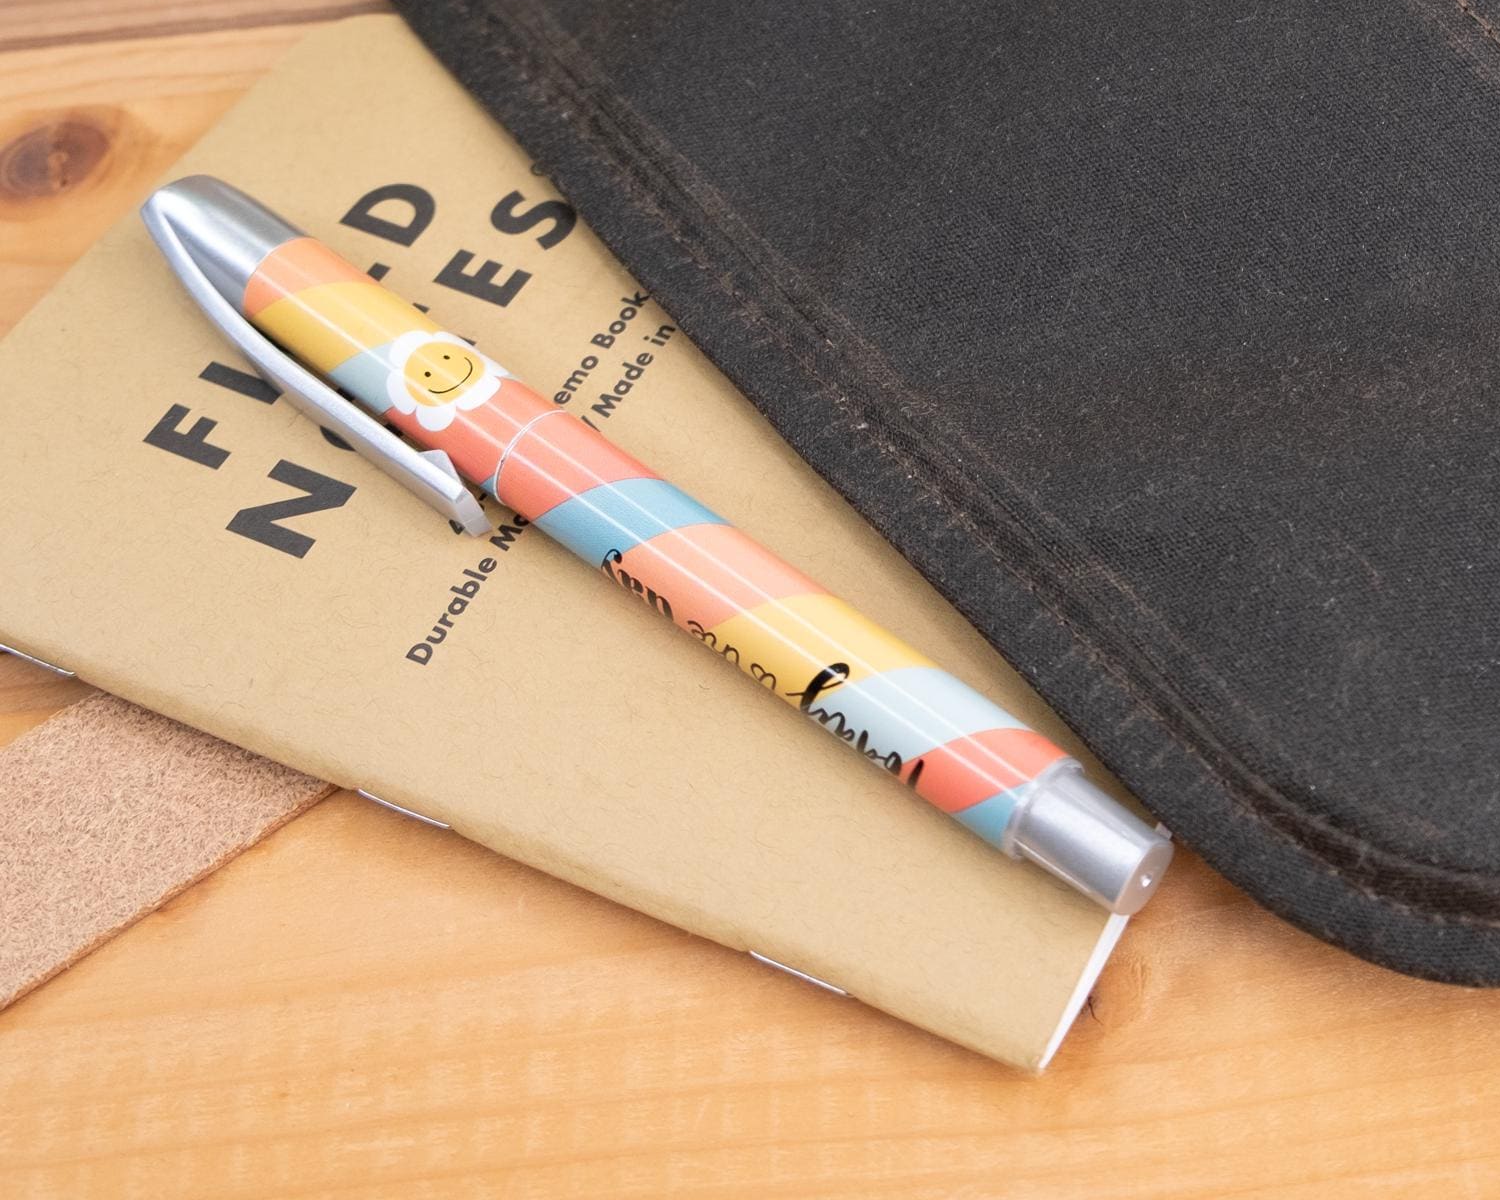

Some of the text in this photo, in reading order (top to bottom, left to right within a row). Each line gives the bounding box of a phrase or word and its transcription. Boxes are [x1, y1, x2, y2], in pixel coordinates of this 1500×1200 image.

[143, 183, 436, 470] FID
[225, 190, 578, 560] NES
[553, 291, 651, 406] emo Book
[405, 557, 498, 666] Durable
[590, 352, 654, 418] Made
[643, 324, 676, 347] in
